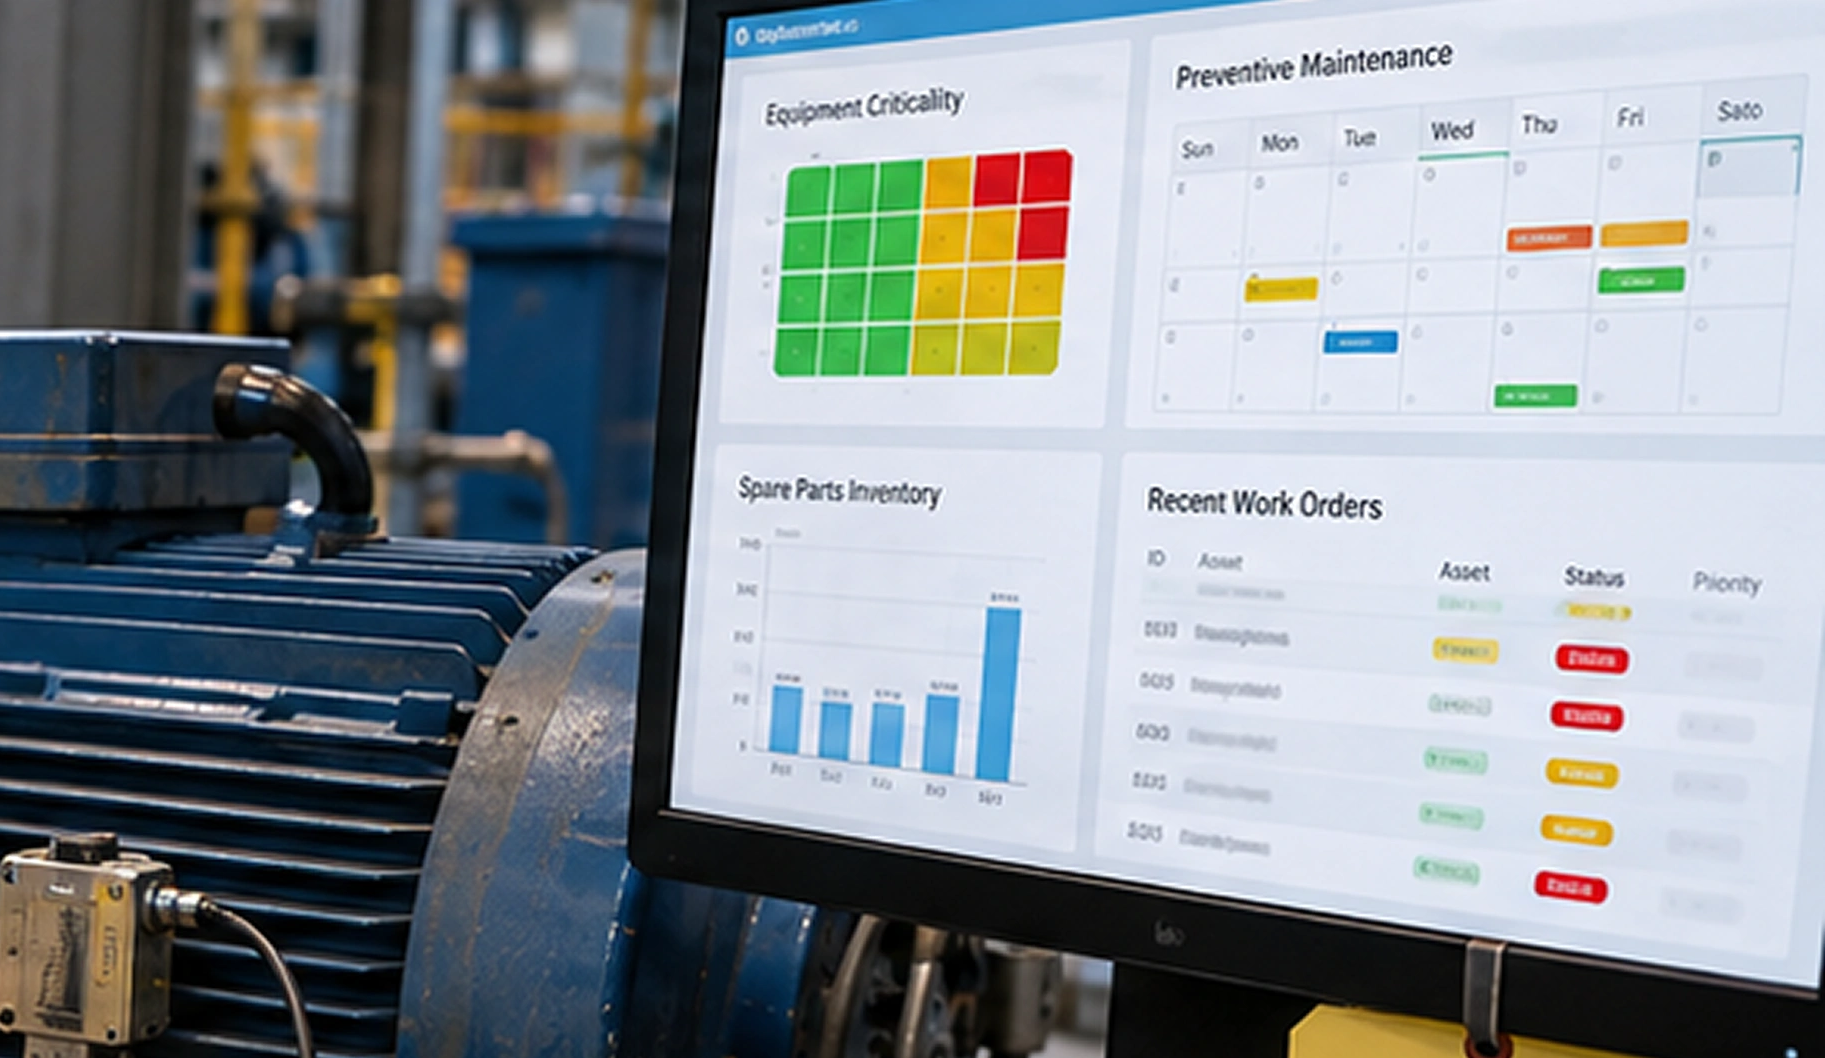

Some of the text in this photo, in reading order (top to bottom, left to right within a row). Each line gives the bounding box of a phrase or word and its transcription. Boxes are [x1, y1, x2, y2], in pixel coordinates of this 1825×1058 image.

[1176, 43, 1454, 89] Preventive Maintenance
[766, 87, 965, 128] Equipment Criticality
[1182, 140, 1214, 159] Sun
[1261, 133, 1299, 152] Mon
[1431, 119, 1475, 141] Wed
[739, 475, 943, 511] Spare Parts Inventory
[1147, 486, 1383, 520] Recent Work Orders
[1147, 549, 1166, 567] ID
[1438, 561, 1491, 583] Asset
[1563, 565, 1626, 588] Status
